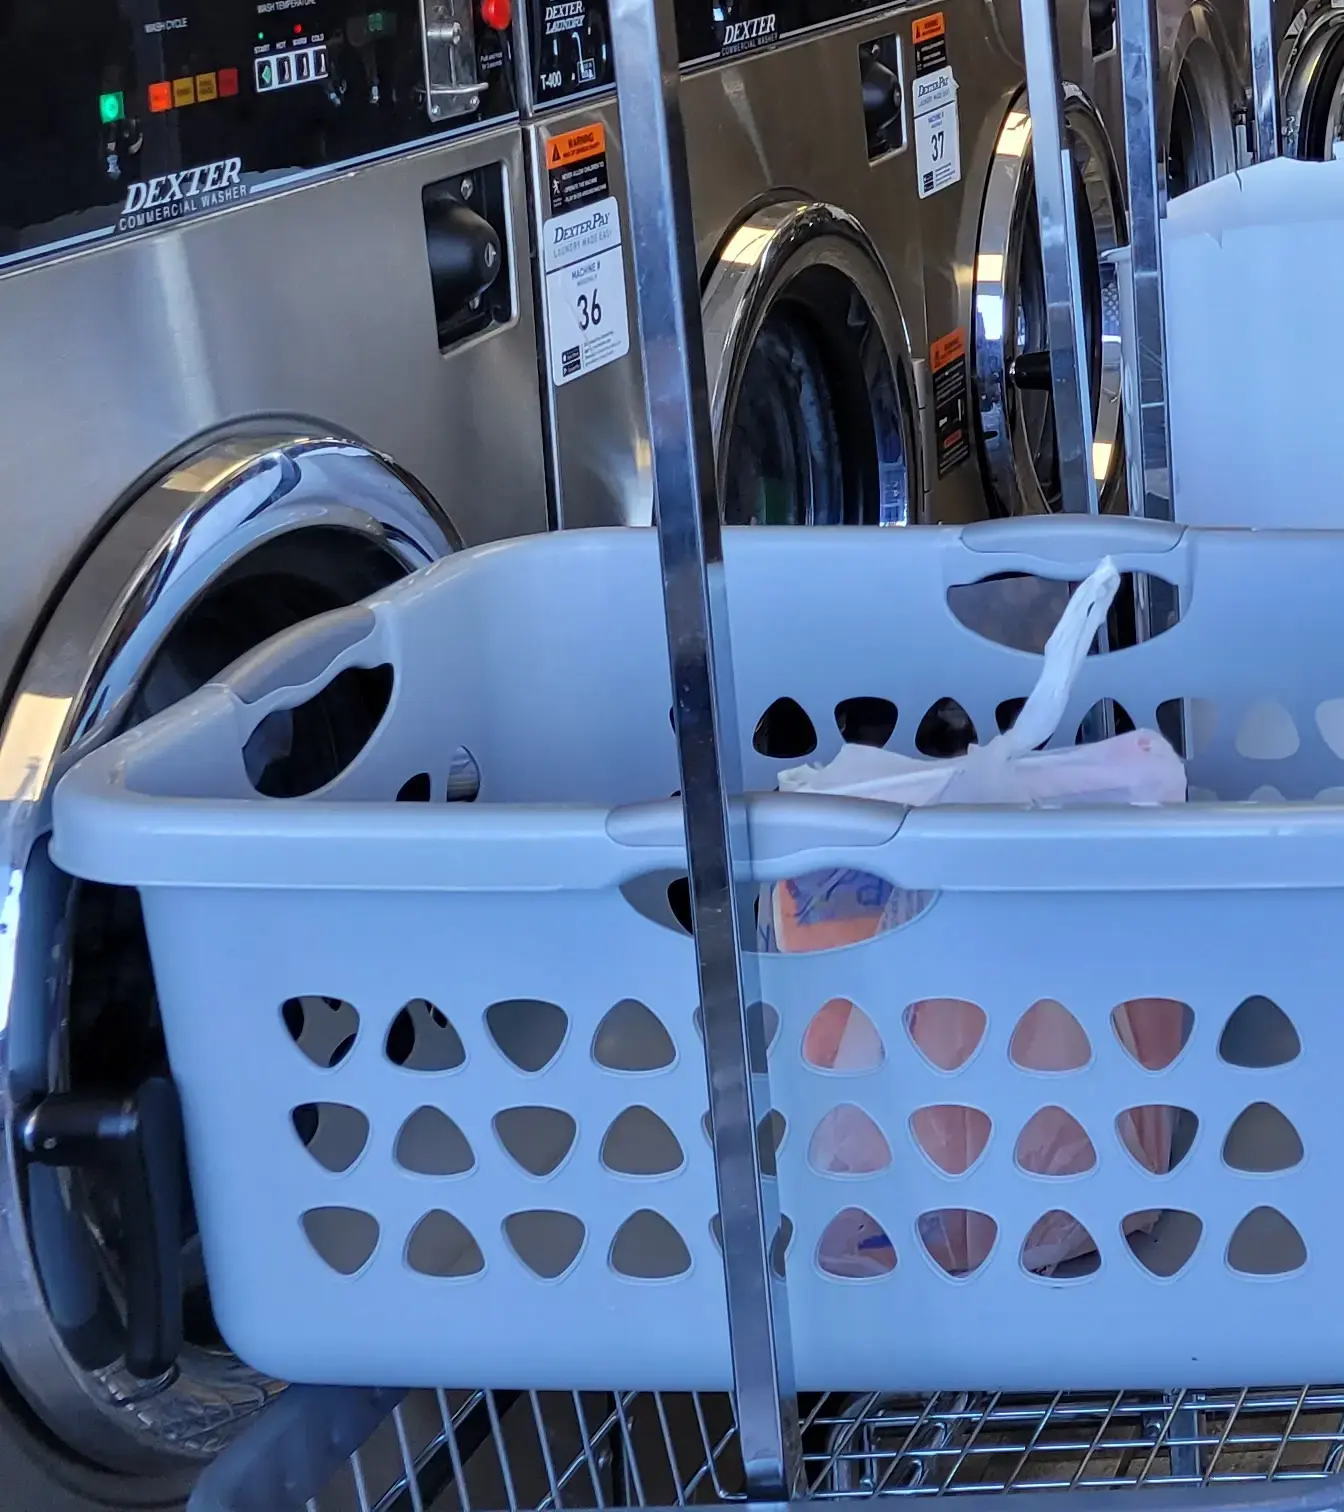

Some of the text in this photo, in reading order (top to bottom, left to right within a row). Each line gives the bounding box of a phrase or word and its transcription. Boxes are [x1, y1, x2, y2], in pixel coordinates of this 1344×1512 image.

[545, 0, 584, 22] DEXTER
[723, 13, 776, 47] DEXTER
[930, 130, 945, 162] 37
[121, 157, 242, 215] DEXTER
[119, 184, 248, 232] COMMERCIAL WASHER
[571, 262, 597, 280] MACHINE
[576, 288, 602, 331] 36
